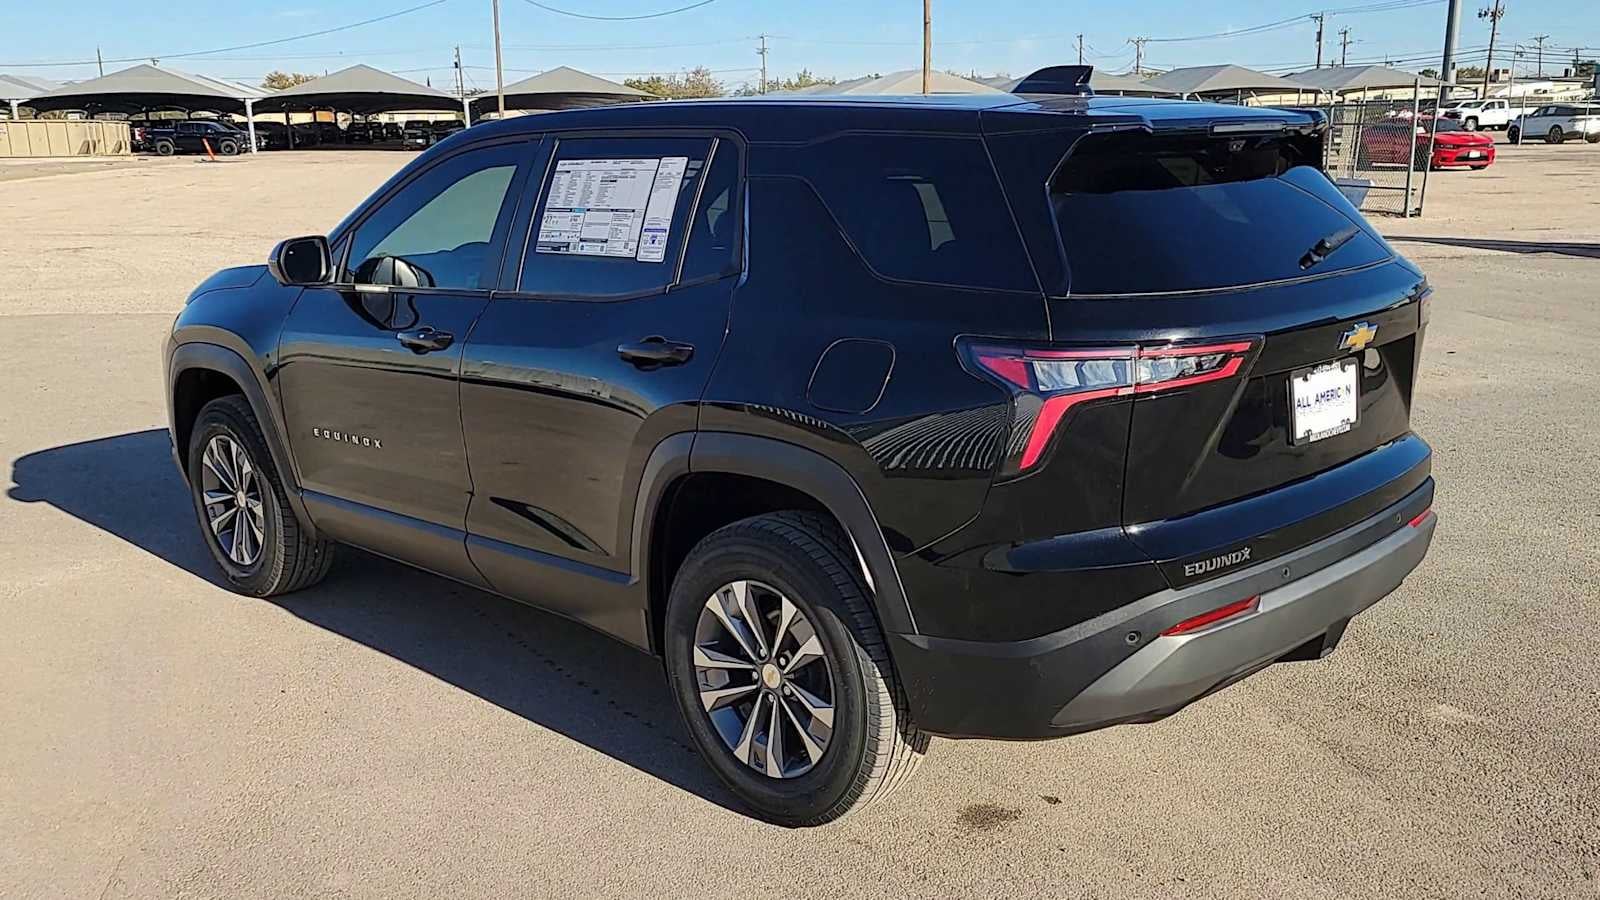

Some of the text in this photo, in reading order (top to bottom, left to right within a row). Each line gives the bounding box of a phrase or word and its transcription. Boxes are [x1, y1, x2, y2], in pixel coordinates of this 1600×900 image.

[1296, 384, 1351, 408] ALL AMERICN
[314, 428, 381, 449] EQUINOX
[1184, 547, 1251, 576] EQUINOX
